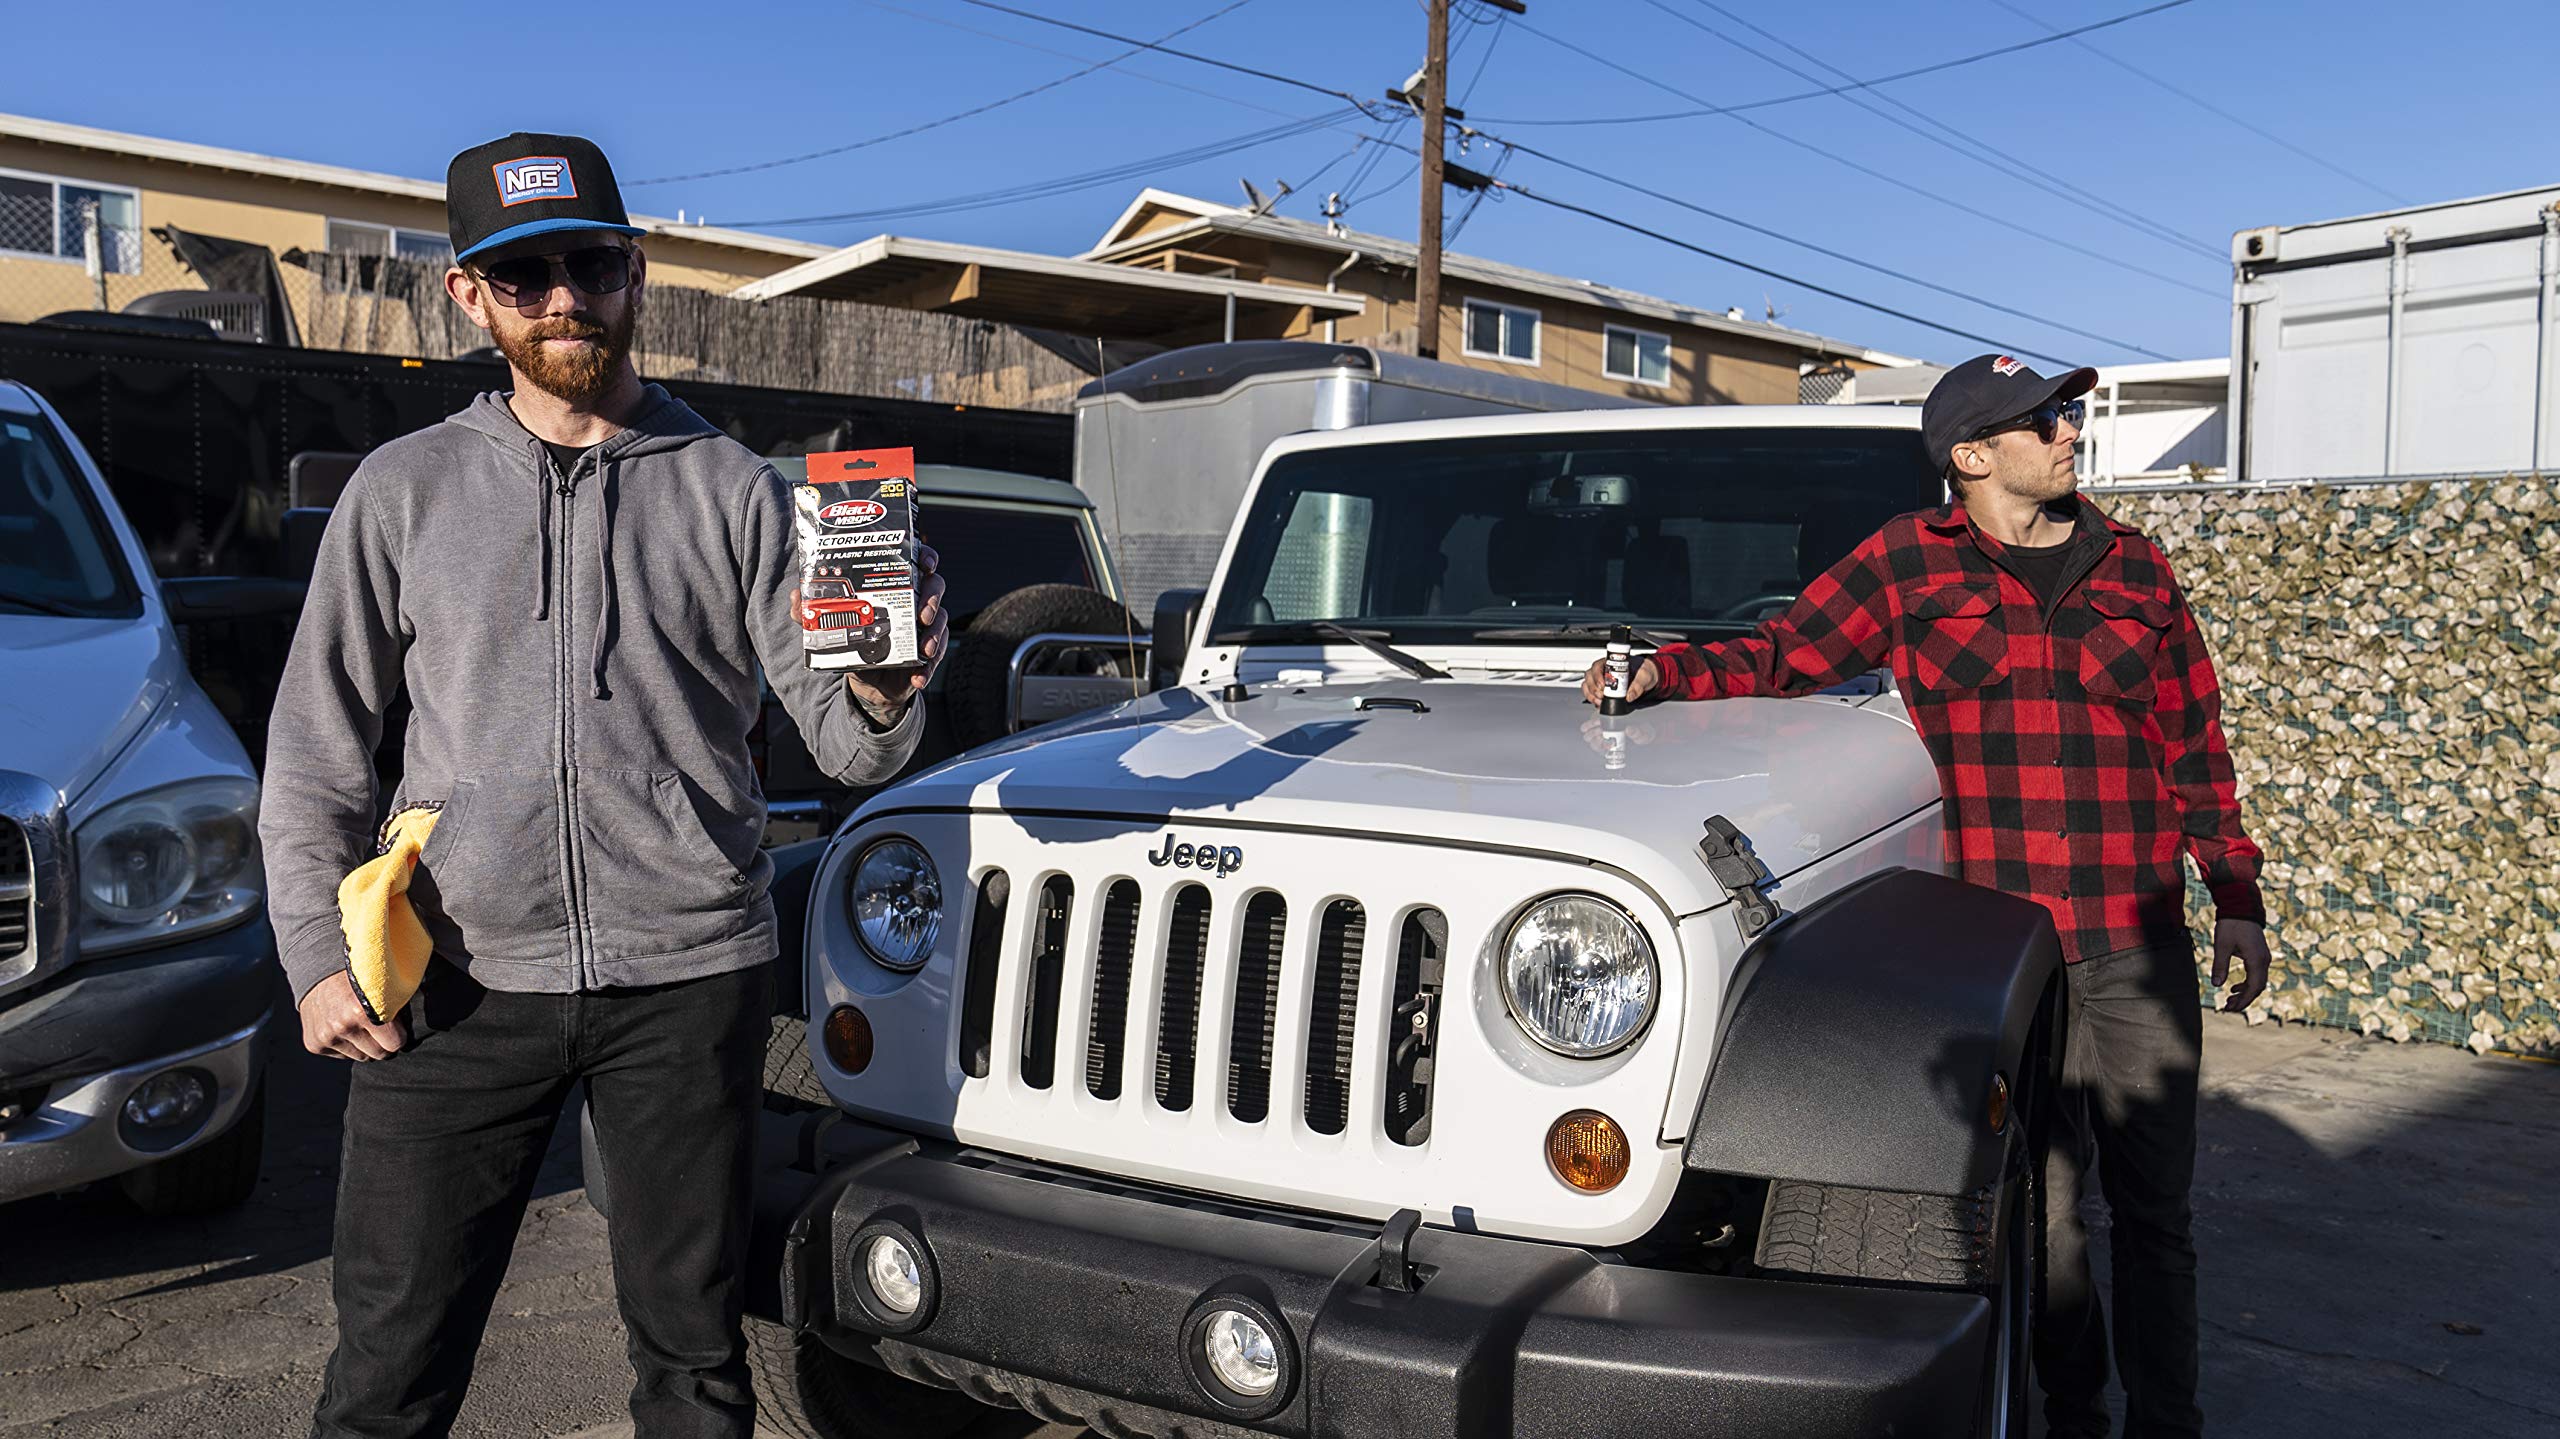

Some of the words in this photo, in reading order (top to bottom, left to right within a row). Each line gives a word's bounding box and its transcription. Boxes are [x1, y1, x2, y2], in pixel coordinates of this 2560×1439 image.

[505, 164, 563, 194] NOS
[508, 189, 535, 200] ENERGY
[880, 483, 905, 493] 200
[828, 503, 877, 517] Black
[835, 515, 877, 526] Magic
[862, 533, 902, 544] BLACK
[832, 551, 862, 560] PLASTIC
[864, 549, 902, 557] RESTORER
[1148, 833, 1243, 879] Jeep
